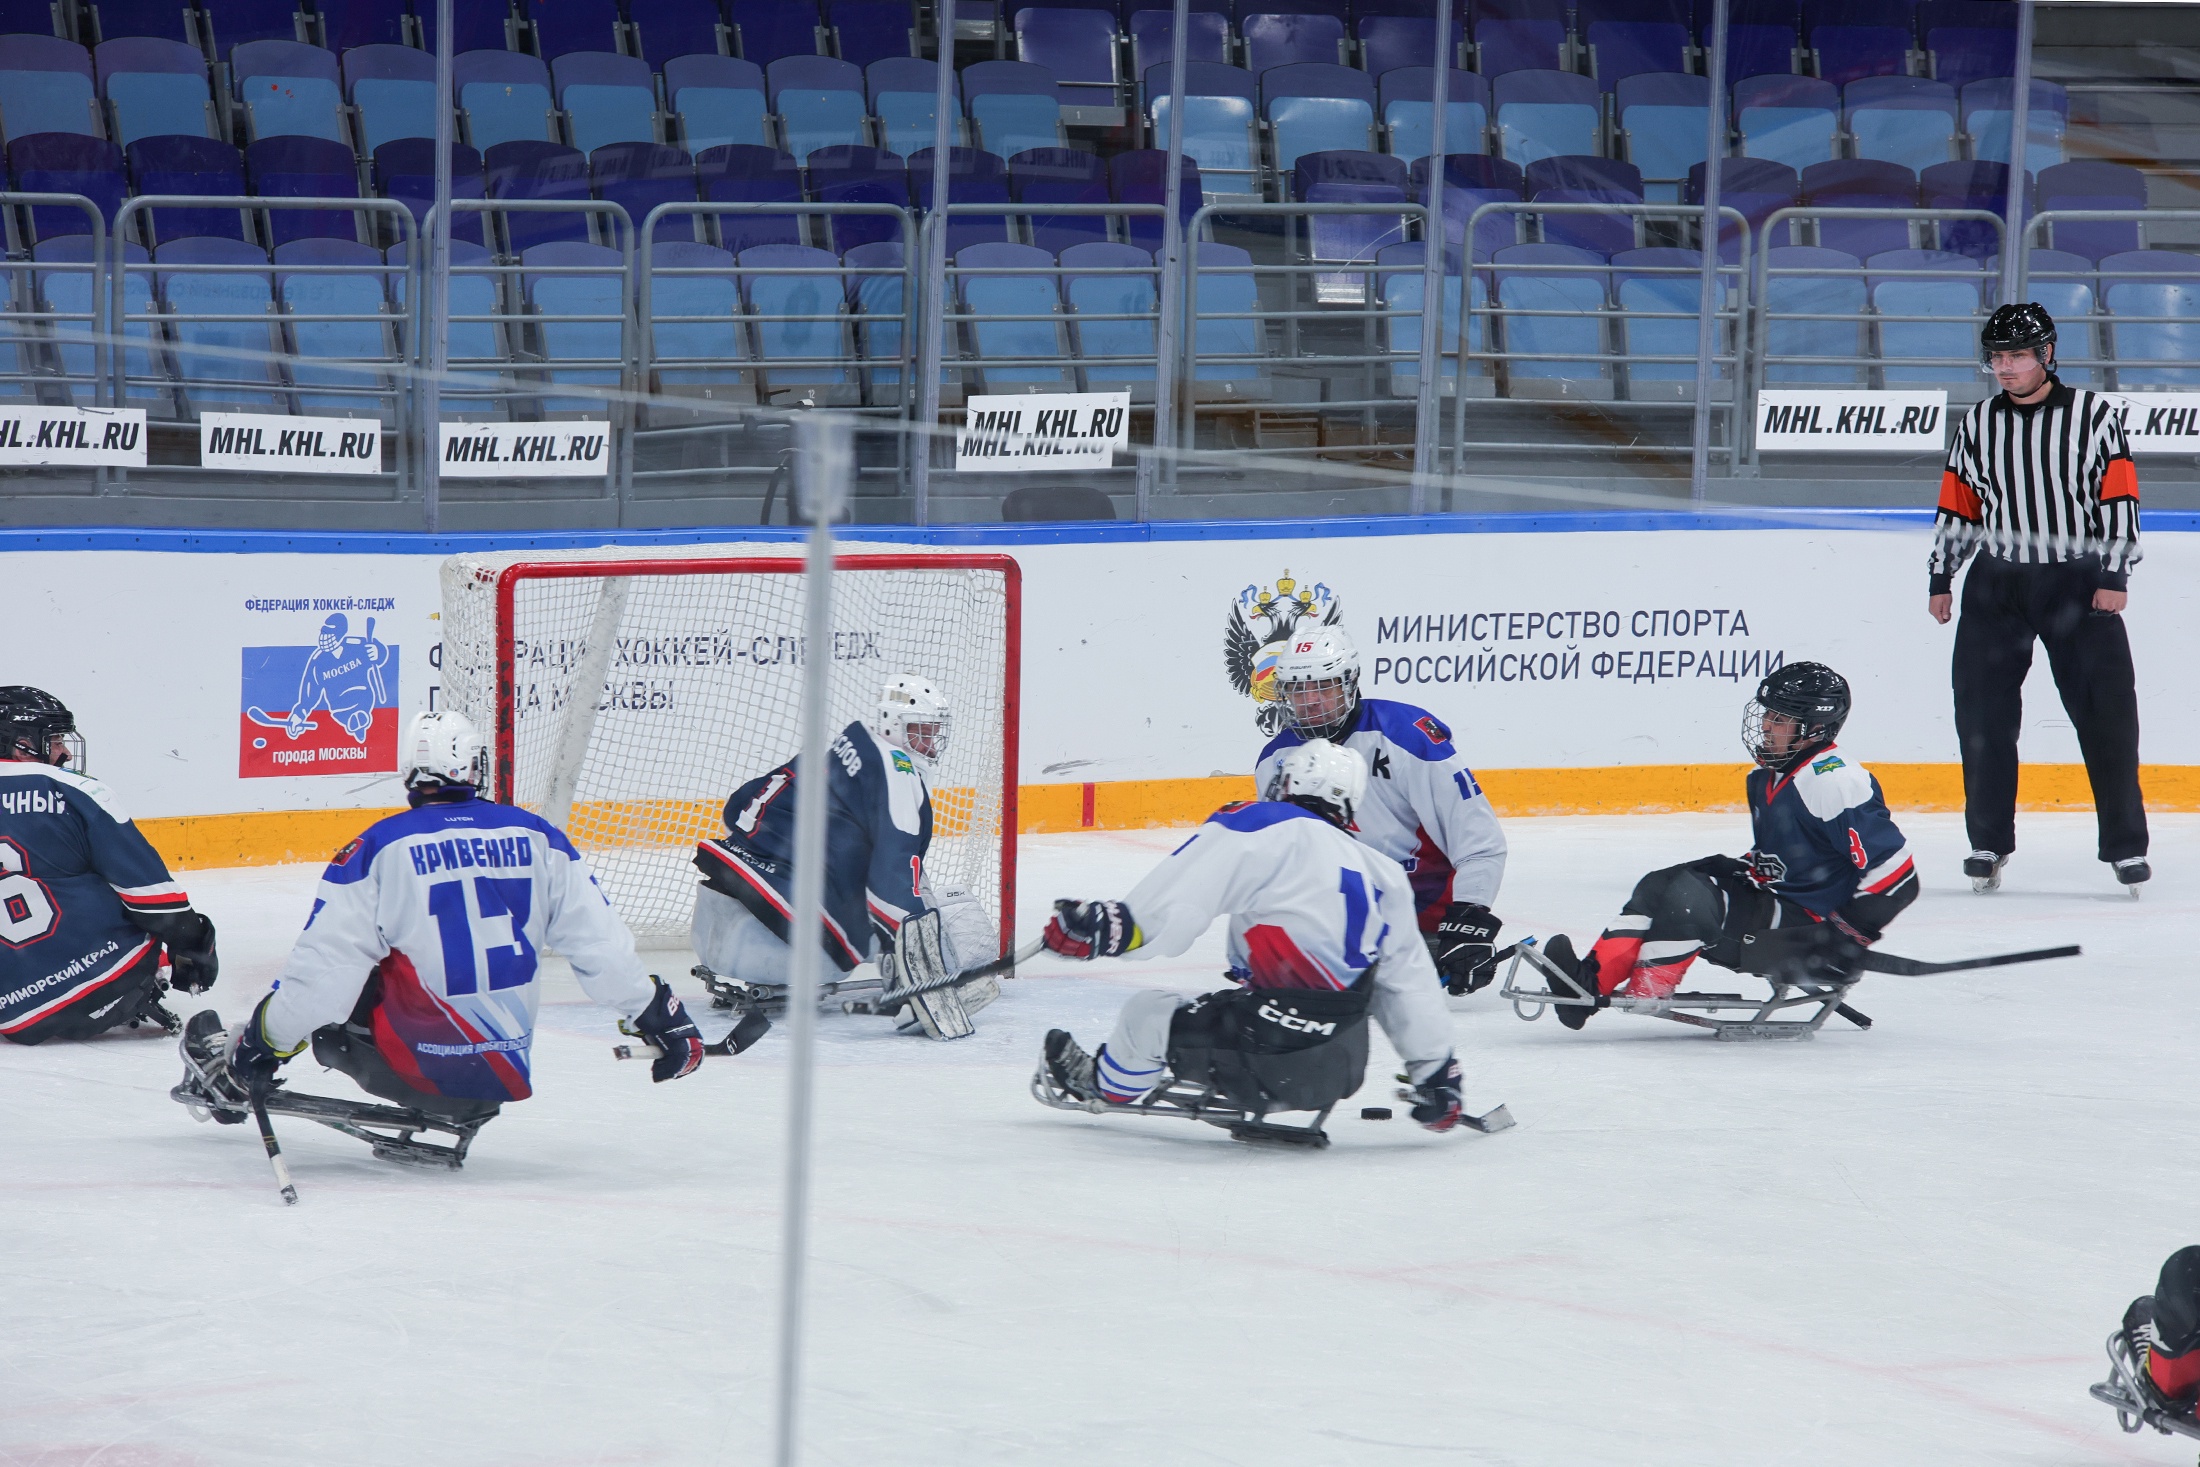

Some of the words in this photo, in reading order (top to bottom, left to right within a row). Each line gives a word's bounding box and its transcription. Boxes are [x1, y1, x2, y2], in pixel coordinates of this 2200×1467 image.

[703, 388, 711, 399] 11
[807, 389, 816, 399] 12
[1557, 385, 1565, 395] 2
[973, 408, 1124, 438] MHL.KHL.RU
[1763, 405, 1940, 434] MHL.KHL.RU
[209, 427, 375, 459] MHL.KHL.RU
[445, 435, 604, 462] MHL.KHL.RU
[244, 599, 310, 612] ФЕДЕРАЦИЯ
[313, 596, 395, 611] ХОККЕЙ-СЛЕДЖ
[1377, 611, 1620, 644] МИНИСТЕРСТВО
[1631, 609, 1750, 638] СПОРТА
[1295, 642, 1314, 654] 15
[322, 658, 362, 680] МОСКВА
[1374, 644, 1580, 685] РОССИЙСКОЙ
[1591, 650, 1784, 684] ФЕДЕРАЦИИ
[1760, 685, 1769, 697] 8
[272, 750, 315, 766] города
[319, 747, 367, 762] МОСКВЫ
[1372, 748, 1391, 780] К
[408, 836, 533, 876] КРИВЕНКО
[428, 876, 538, 997] 13
[0, 958, 85, 1010] РИМОРСКИЙ
[85, 940, 120, 969] КРАЙ
[1258, 1004, 1338, 1036] CCM
[417, 1042, 473, 1057] АССОЦИАЦИЯ
